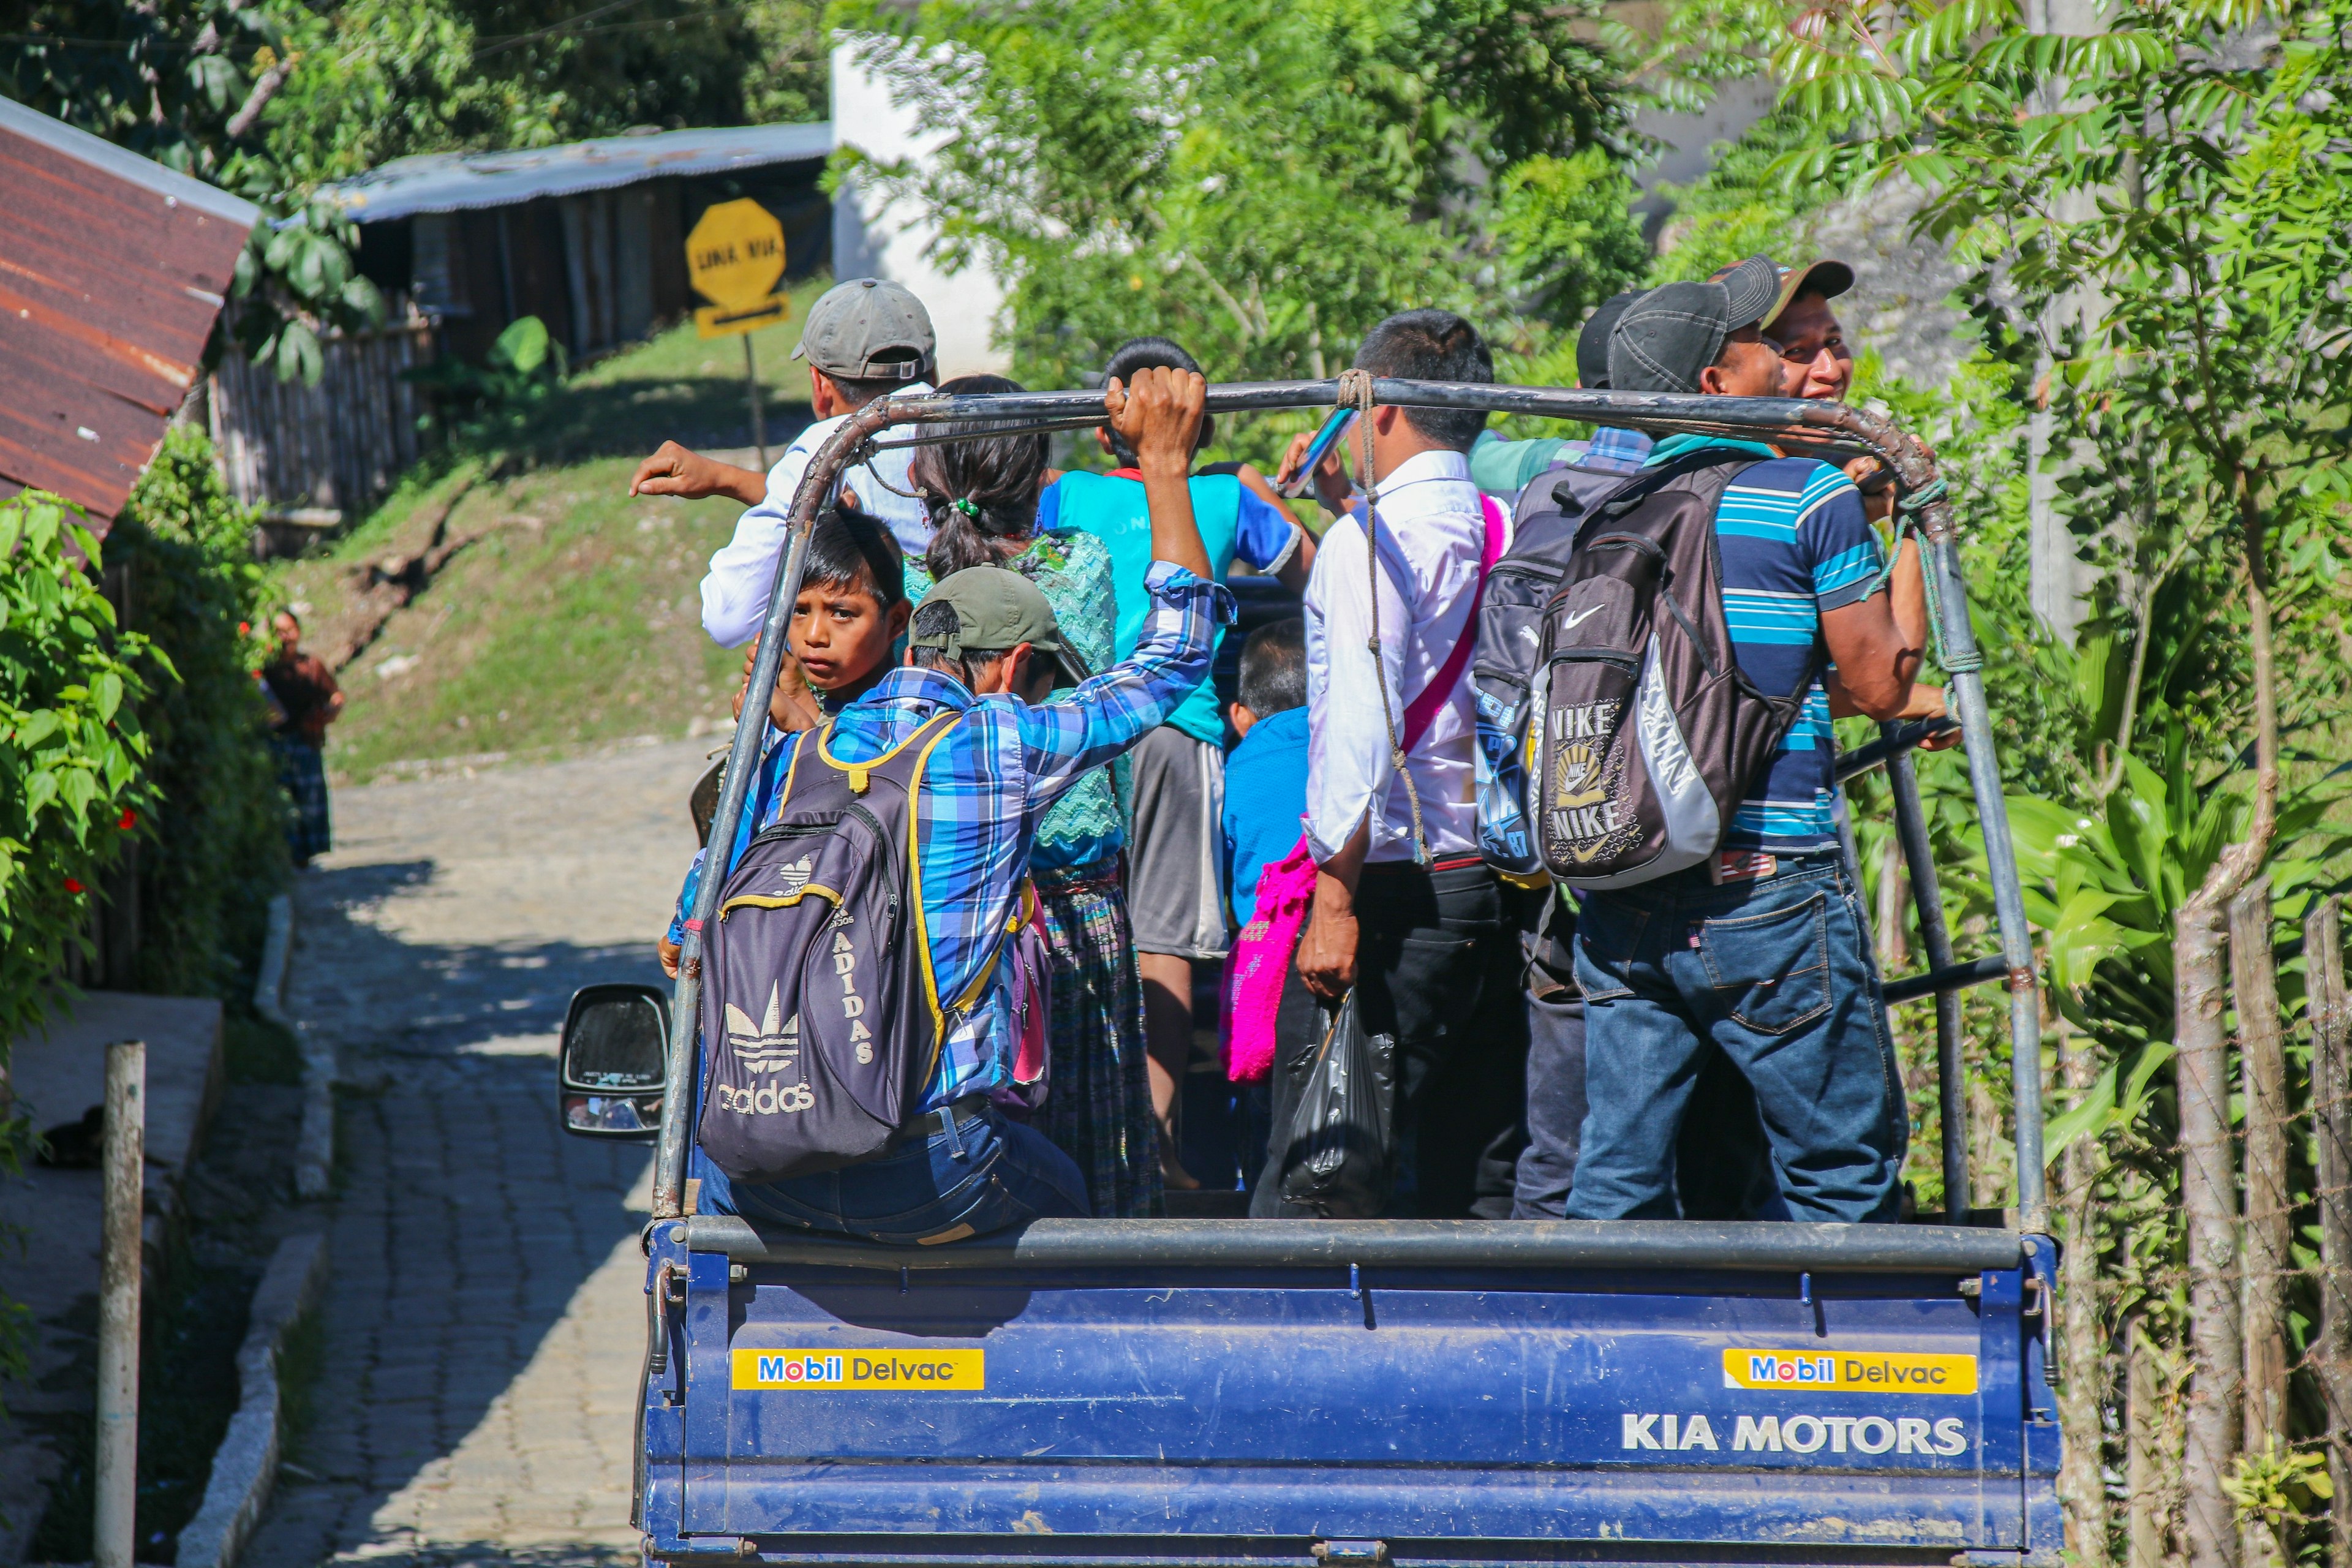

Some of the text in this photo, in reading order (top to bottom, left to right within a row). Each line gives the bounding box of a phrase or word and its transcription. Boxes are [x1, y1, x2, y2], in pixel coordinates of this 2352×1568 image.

[1553, 704, 1612, 740] NIKE
[1569, 762, 1586, 778] NIKE
[1553, 800, 1623, 840] NIKE
[1507, 831, 1529, 858] 87
[832, 931, 874, 1065] ADIDAS
[718, 1079, 815, 1115] adidas
[759, 1356, 842, 1382] Mobil
[1750, 1355, 1834, 1383] Mobil
[1621, 1413, 1967, 1456] KIA MOTORS
